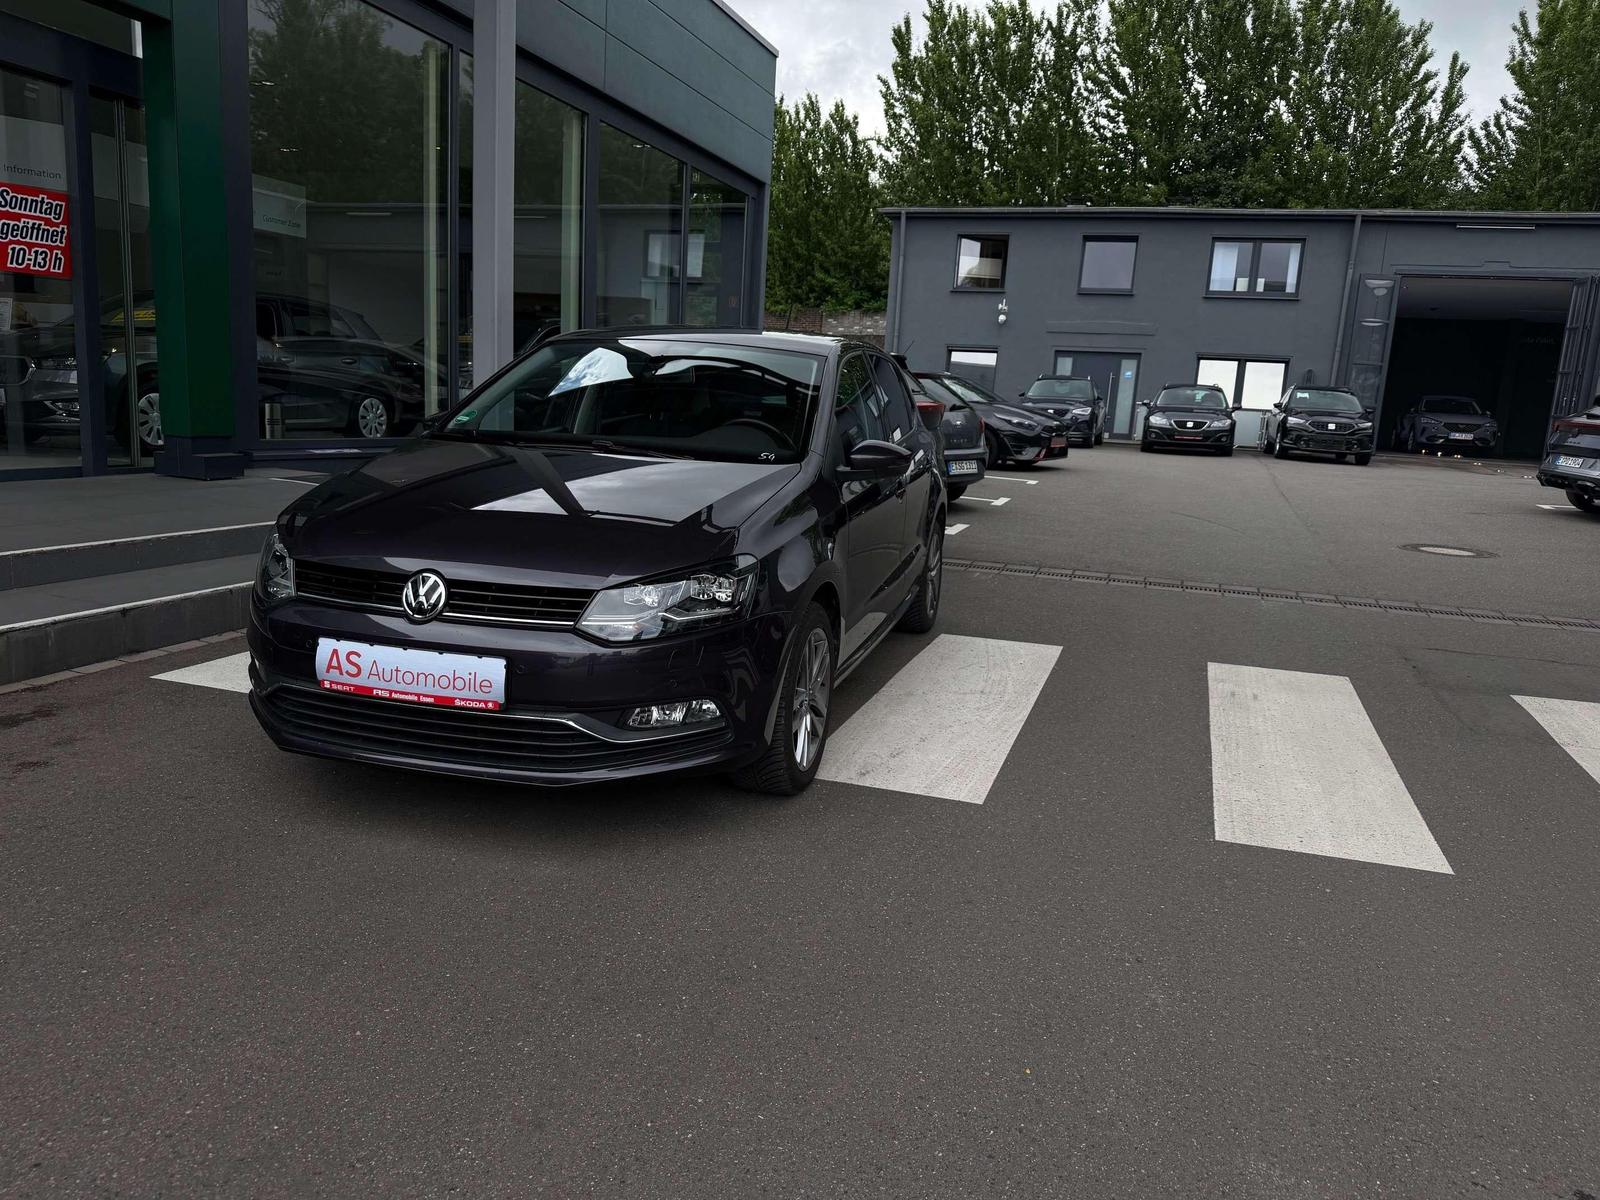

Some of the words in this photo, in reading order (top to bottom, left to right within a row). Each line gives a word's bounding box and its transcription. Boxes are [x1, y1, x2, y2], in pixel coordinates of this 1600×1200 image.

[4, 164, 62, 180] Information
[0, 187, 65, 222] Sonntag
[0, 219, 67, 246] geöffnet
[8, 245, 49, 271] 10-13
[50, 250, 65, 273] h
[325, 648, 362, 679] AS
[367, 660, 493, 694] Automobile
[331, 683, 355, 692] SEAT
